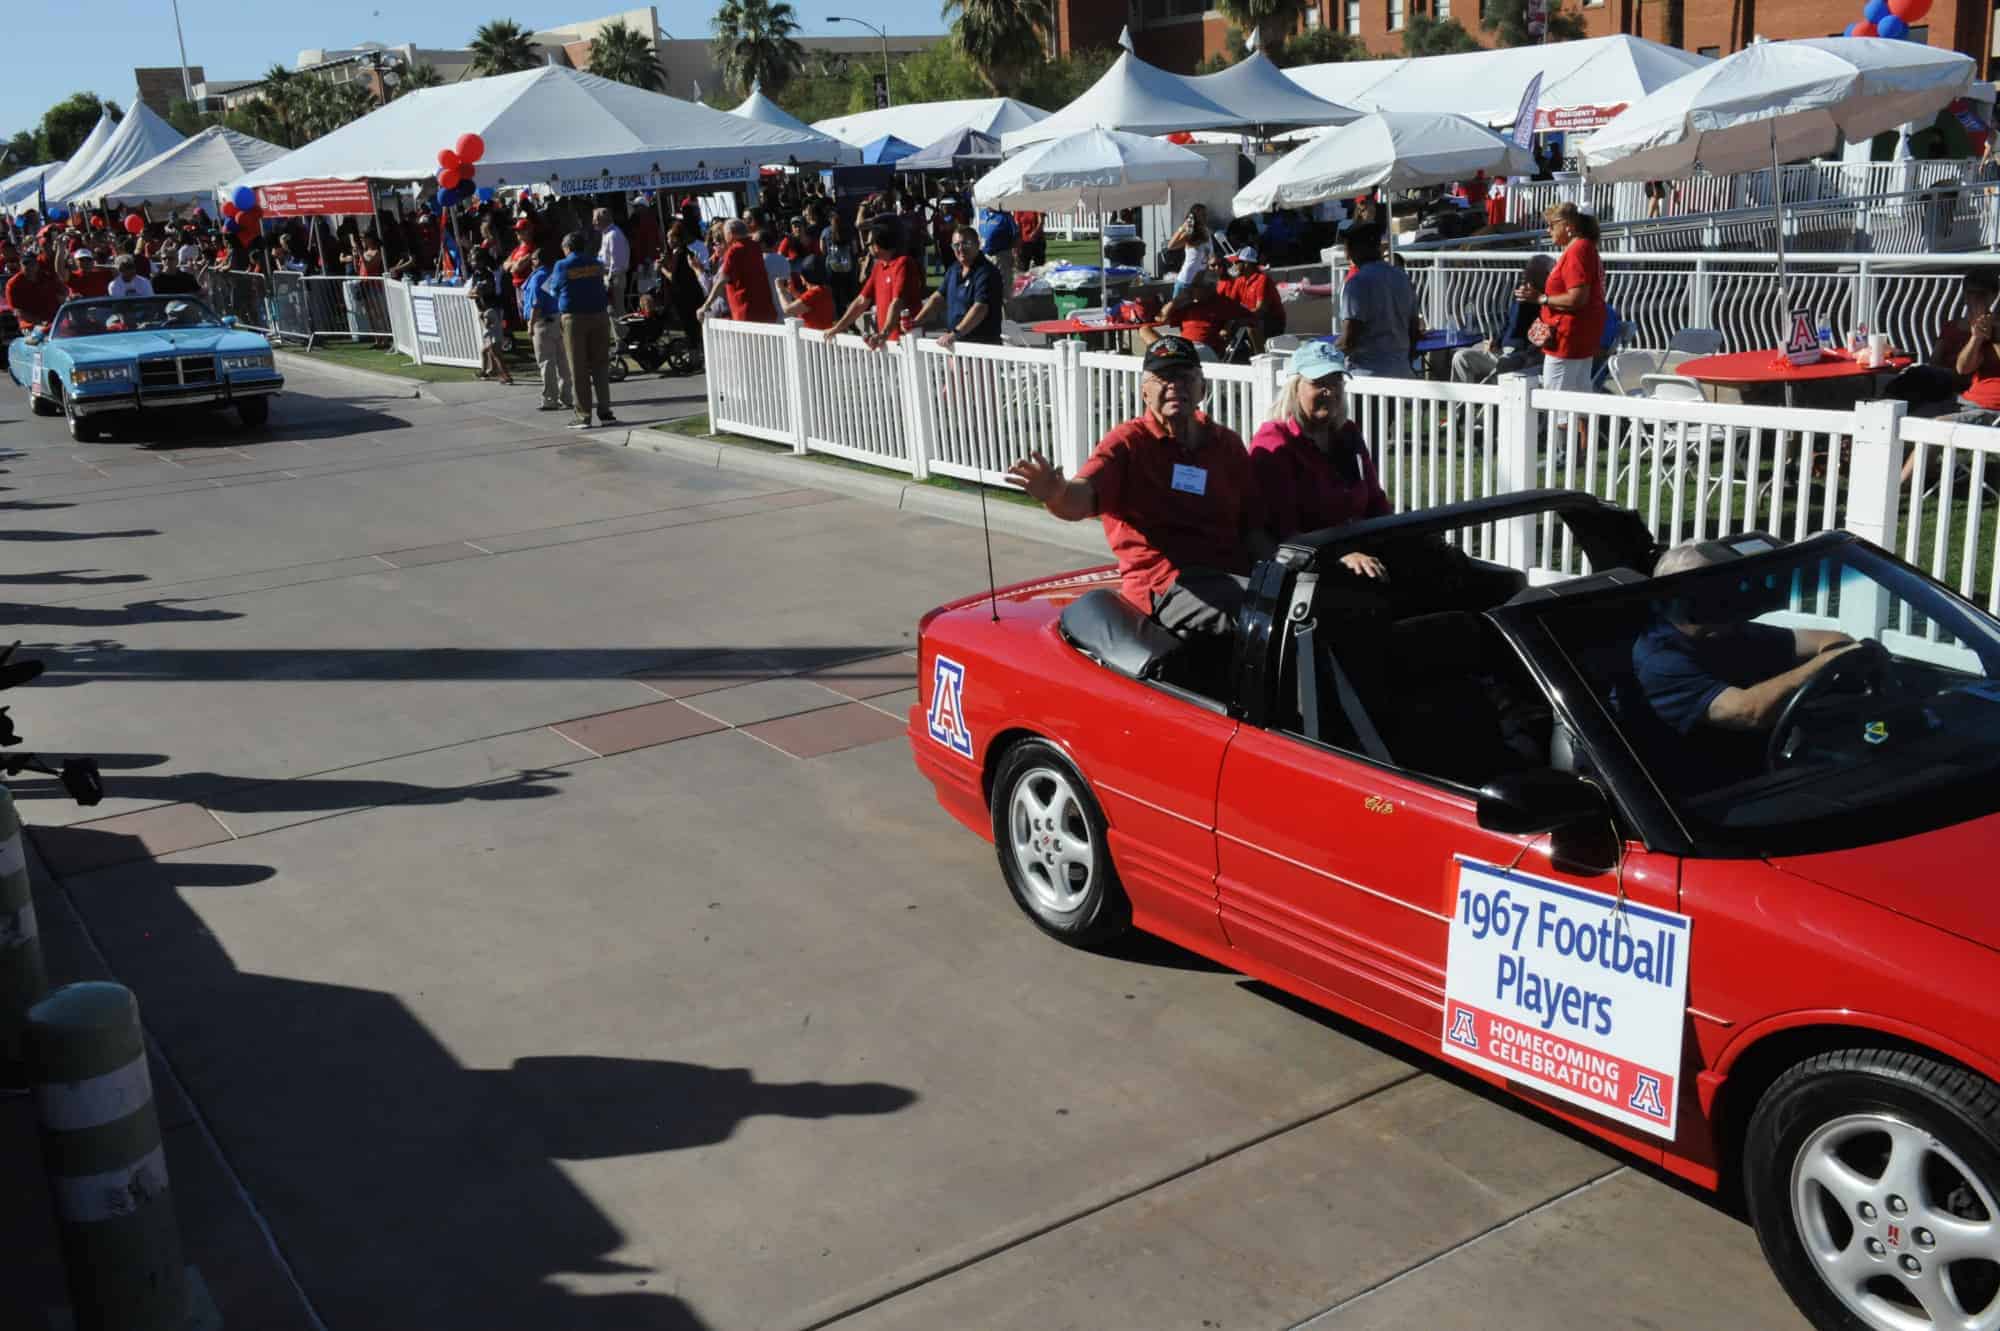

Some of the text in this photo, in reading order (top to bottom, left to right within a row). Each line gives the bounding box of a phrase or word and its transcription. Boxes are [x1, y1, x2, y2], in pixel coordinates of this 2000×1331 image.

[561, 178, 599, 194] COLLEGE
[602, 177, 615, 190] OF
[1786, 308, 1820, 354] A
[926, 654, 974, 760] A
[1460, 888, 1676, 988] 1967 Football
[1496, 953, 1613, 1036] Players
[1449, 1008, 1478, 1048] A
[1489, 1020, 1621, 1080] HOMECOMING
[1489, 1038, 1619, 1102] CELEBRATION
[1629, 1074, 1664, 1118] A
